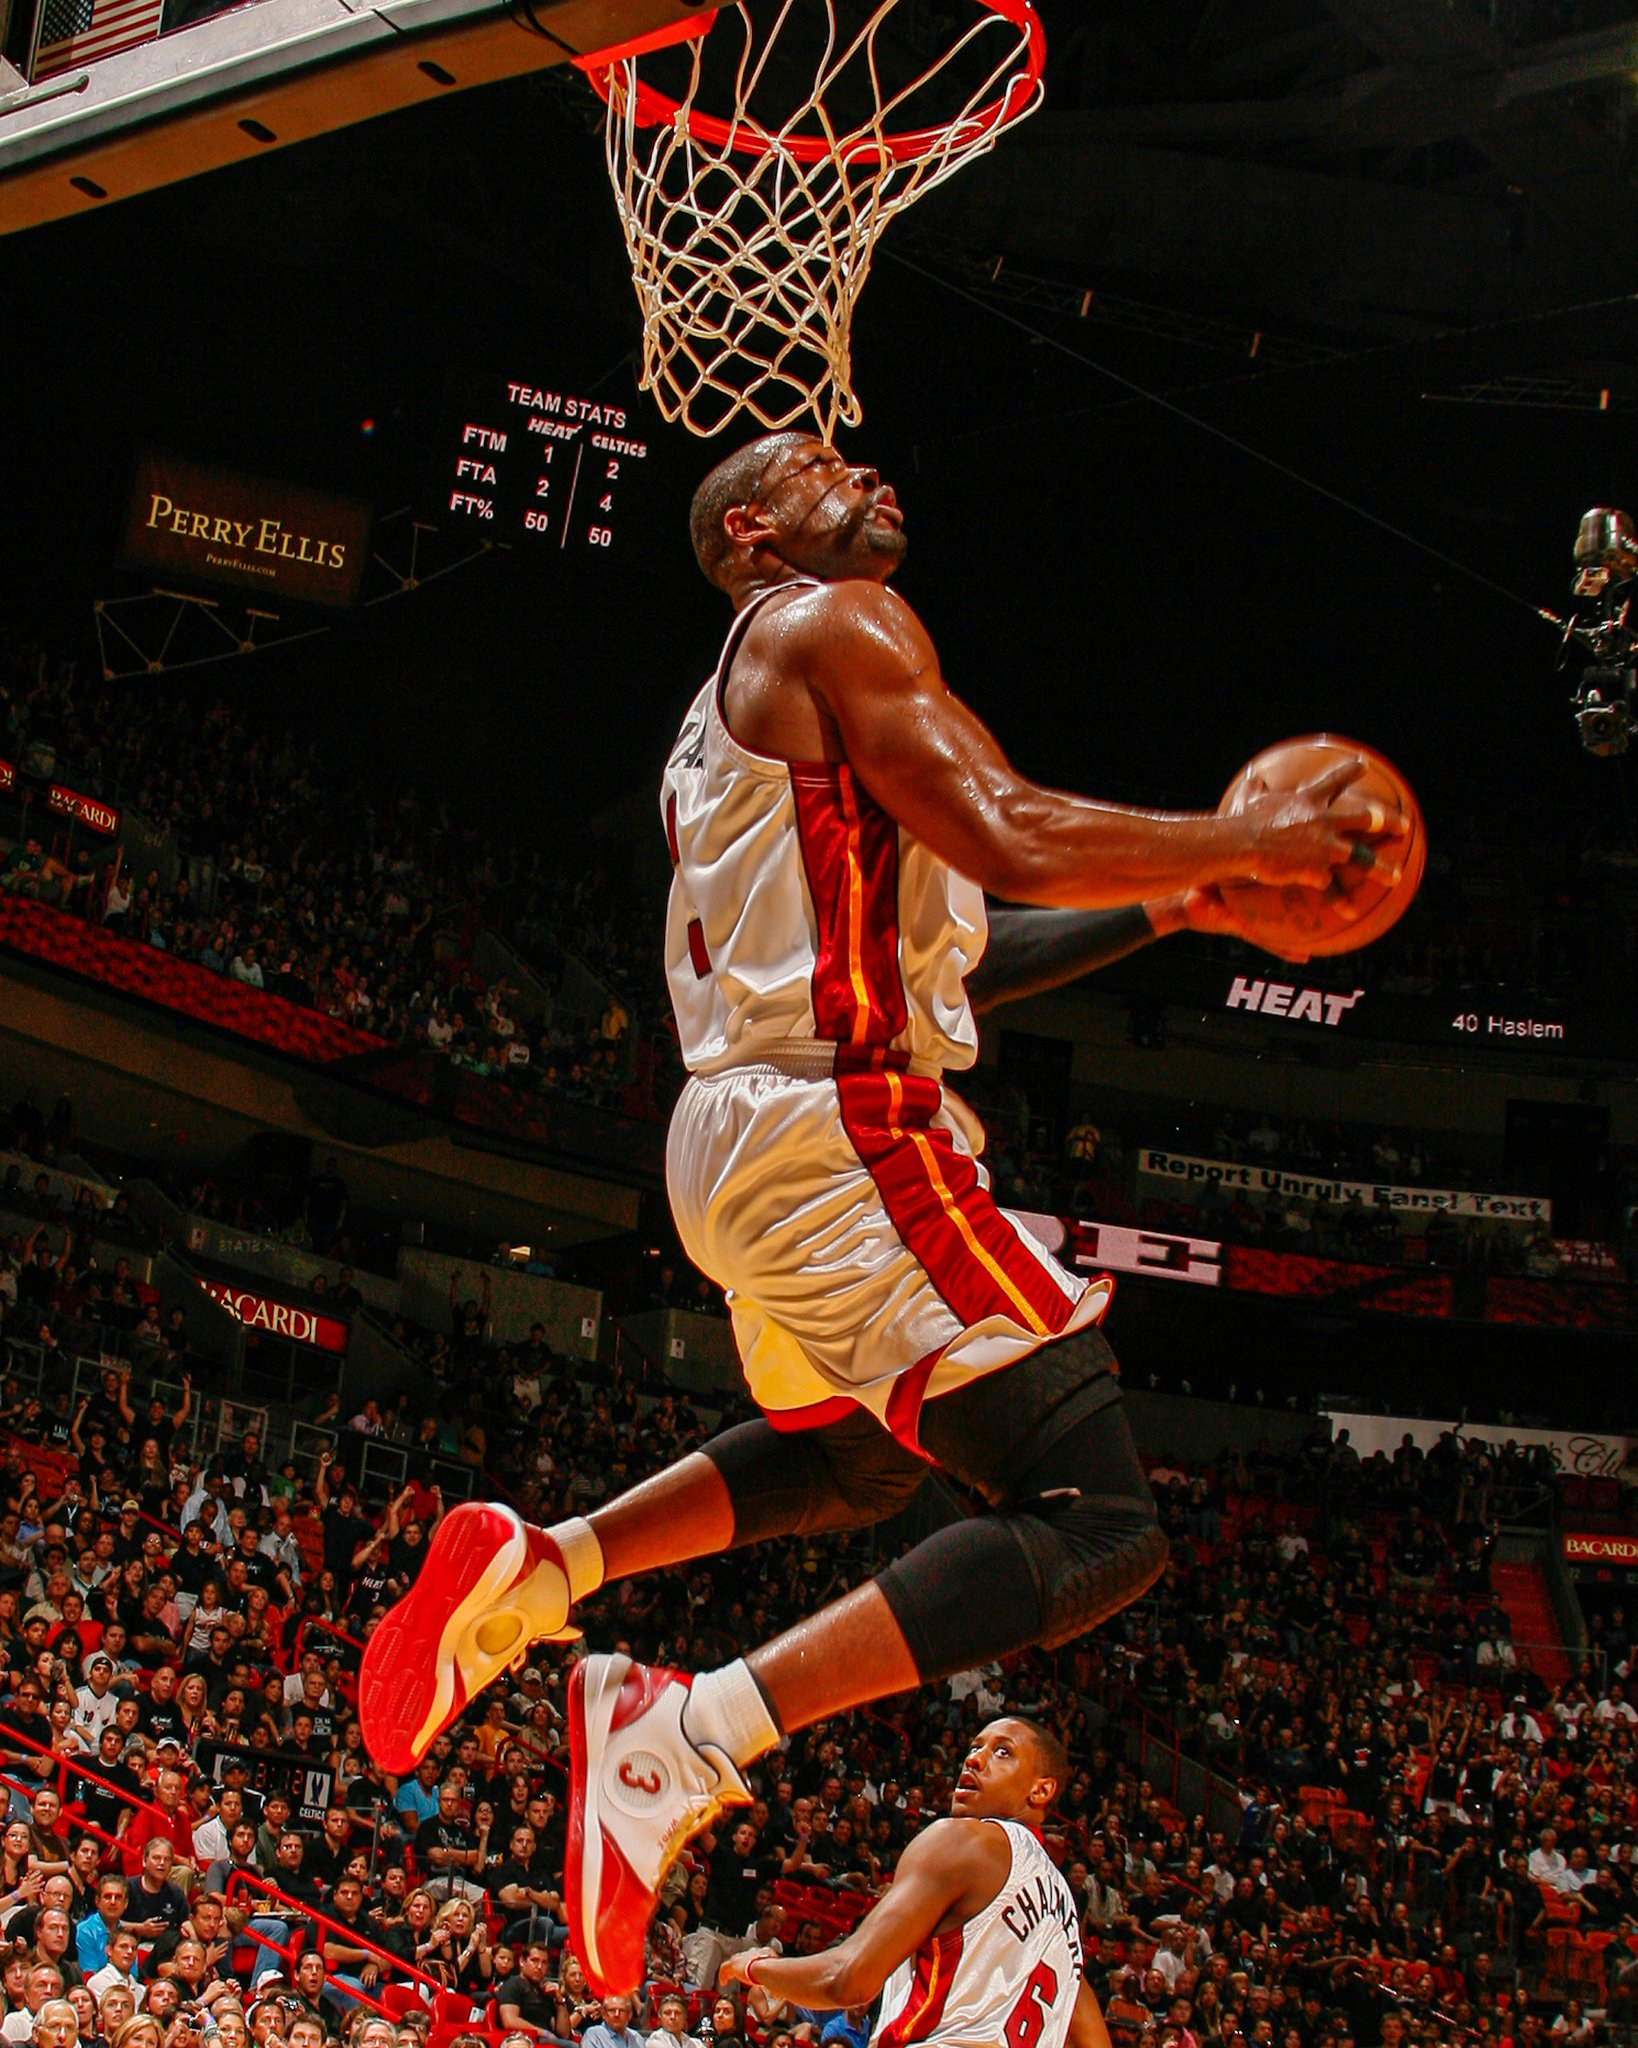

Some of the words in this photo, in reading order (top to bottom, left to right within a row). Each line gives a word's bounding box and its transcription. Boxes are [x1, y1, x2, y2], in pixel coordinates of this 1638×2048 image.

[507, 384, 562, 413] TEAM
[563, 400, 627, 430] STATS
[463, 426, 508, 453] FTM
[544, 444, 555, 464] 1
[606, 460, 620, 480] 2
[527, 417, 583, 441] HEAT
[591, 434, 648, 459] CELTICS
[456, 459, 497, 485] FTA
[536, 479, 551, 498] 2
[600, 495, 613, 513] 4
[145, 493, 252, 548] PERRY
[254, 518, 346, 569] ELLIS
[449, 493, 494, 521] FT%
[524, 511, 549, 533] 50
[588, 526, 613, 548] 50
[1225, 975, 1365, 1026] HEAT
[1452, 1013, 1480, 1034] 40
[1487, 1015, 1565, 1040] Haslem
[1147, 1152, 1250, 1186] Report
[1469, 1194, 1542, 1218] Text
[200, 1279, 318, 1345] ACARDI
[618, 1762, 662, 1795] 3
[1003, 1959, 1060, 2048] 6
